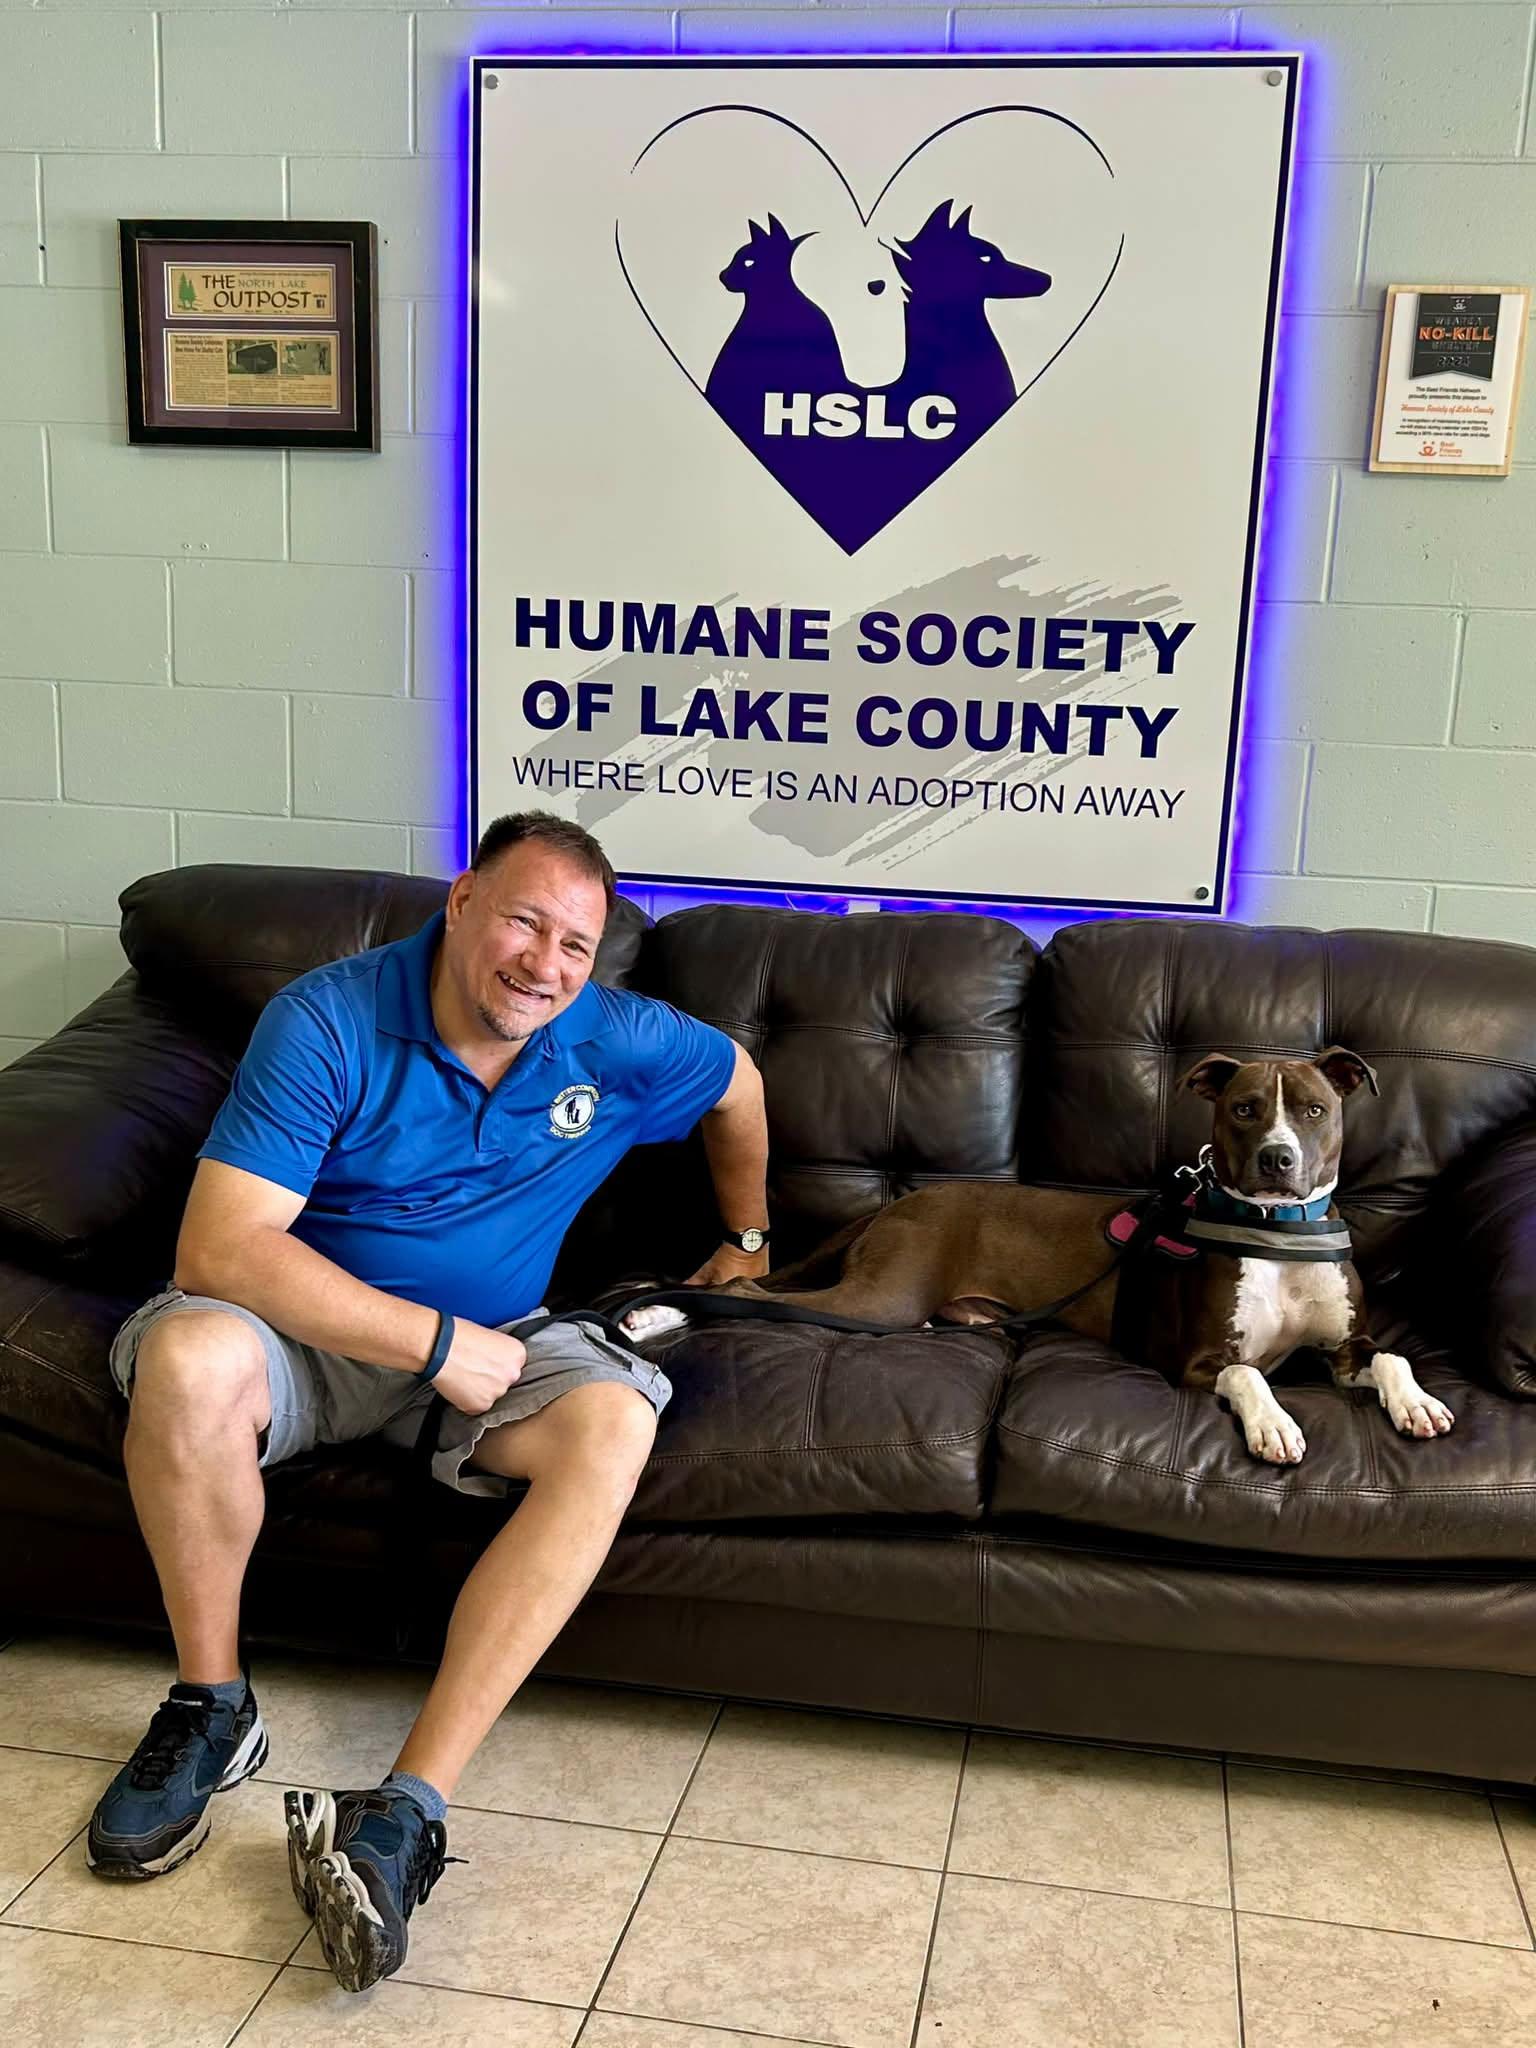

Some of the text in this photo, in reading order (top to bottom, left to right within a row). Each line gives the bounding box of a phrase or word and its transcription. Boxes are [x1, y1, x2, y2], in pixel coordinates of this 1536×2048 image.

[202, 274, 236, 289] THE
[238, 279, 275, 288] NORTH
[281, 279, 307, 289] LAKE
[213, 290, 311, 309] OUTPOST
[1419, 327, 1494, 341] NO-KILL
[764, 392, 957, 440] HSLC
[516, 598, 1196, 675] HUMANE SOCIETY
[523, 680, 1180, 759] OF LAKE COUNTY
[513, 757, 1185, 818] WHERE LOVE IS AN ADOPTION AWAY
